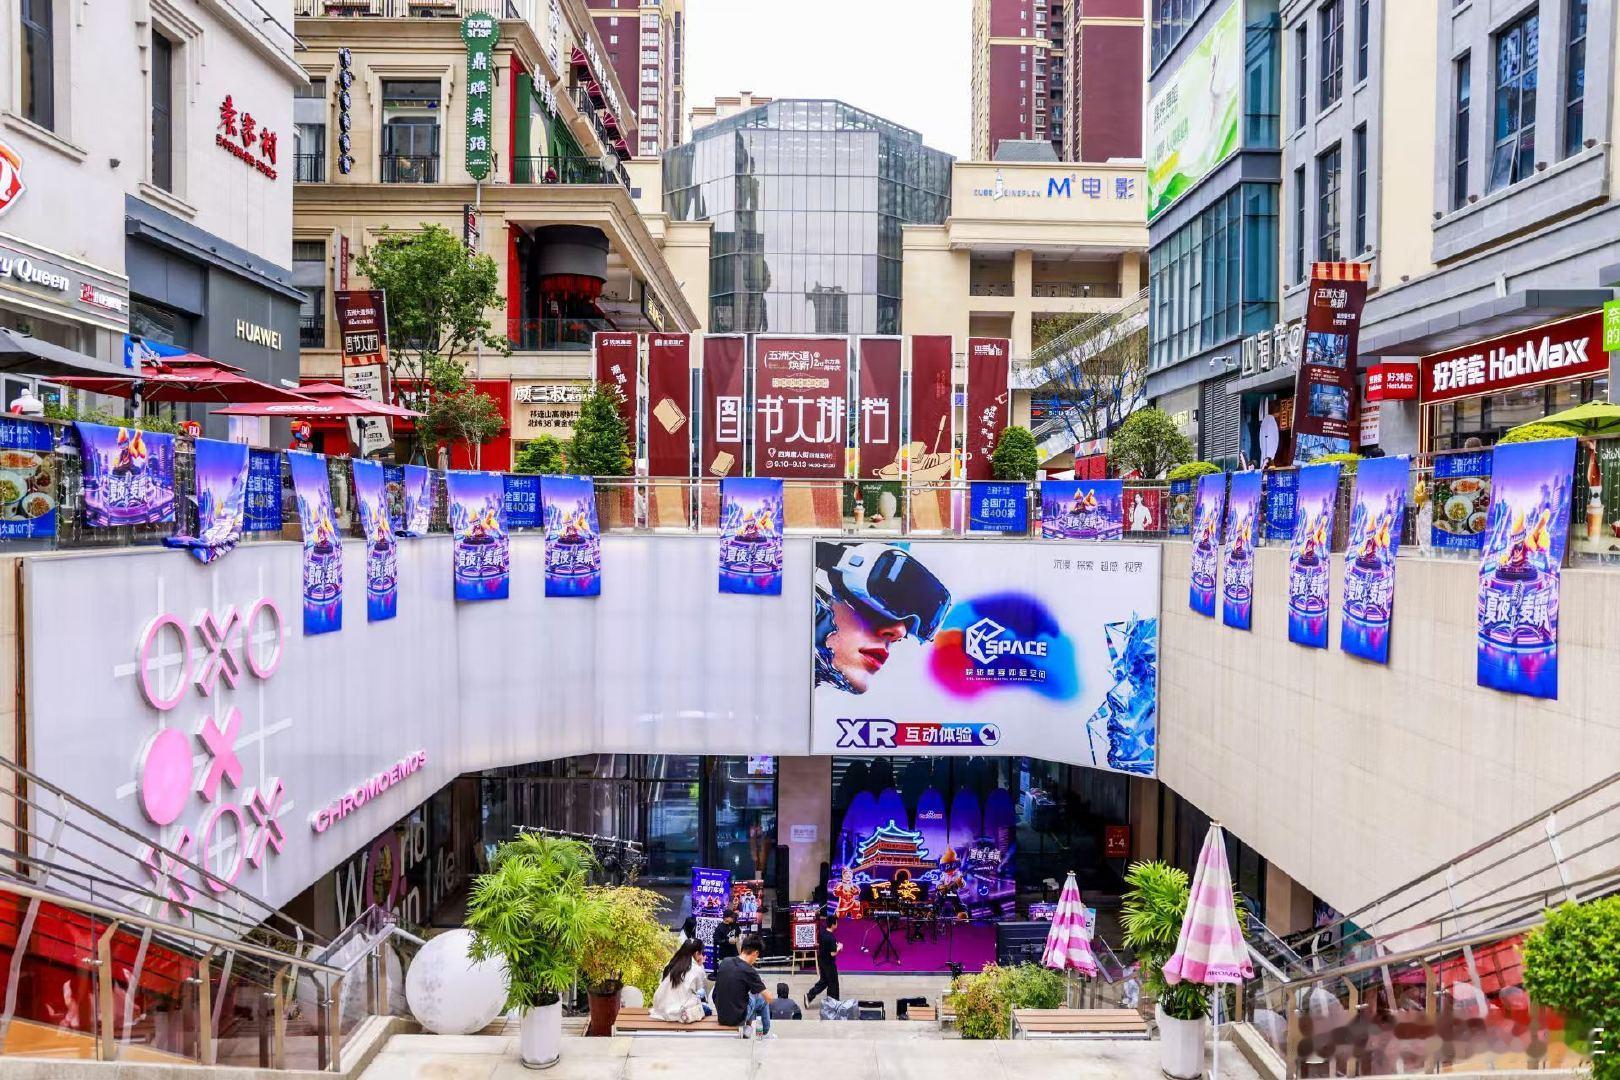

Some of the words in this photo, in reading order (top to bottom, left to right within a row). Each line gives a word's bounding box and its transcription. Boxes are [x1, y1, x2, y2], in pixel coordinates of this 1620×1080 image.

[16, 258, 70, 291] Queen
[236, 318, 282, 351] HUAWEI
[768, 350, 810, 361] 五洲大道
[1432, 355, 1486, 392] 好特卖
[530, 410, 581, 419] 祁连山高原鲜牛
[504, 491, 536, 502] 全国门店
[981, 497, 1016, 508] 全国门店
[980, 508, 1016, 518] 超400家
[836, 718, 897, 748] XR
[905, 726, 972, 743] 互动体验
[311, 750, 427, 833] CHROMOEMOS
